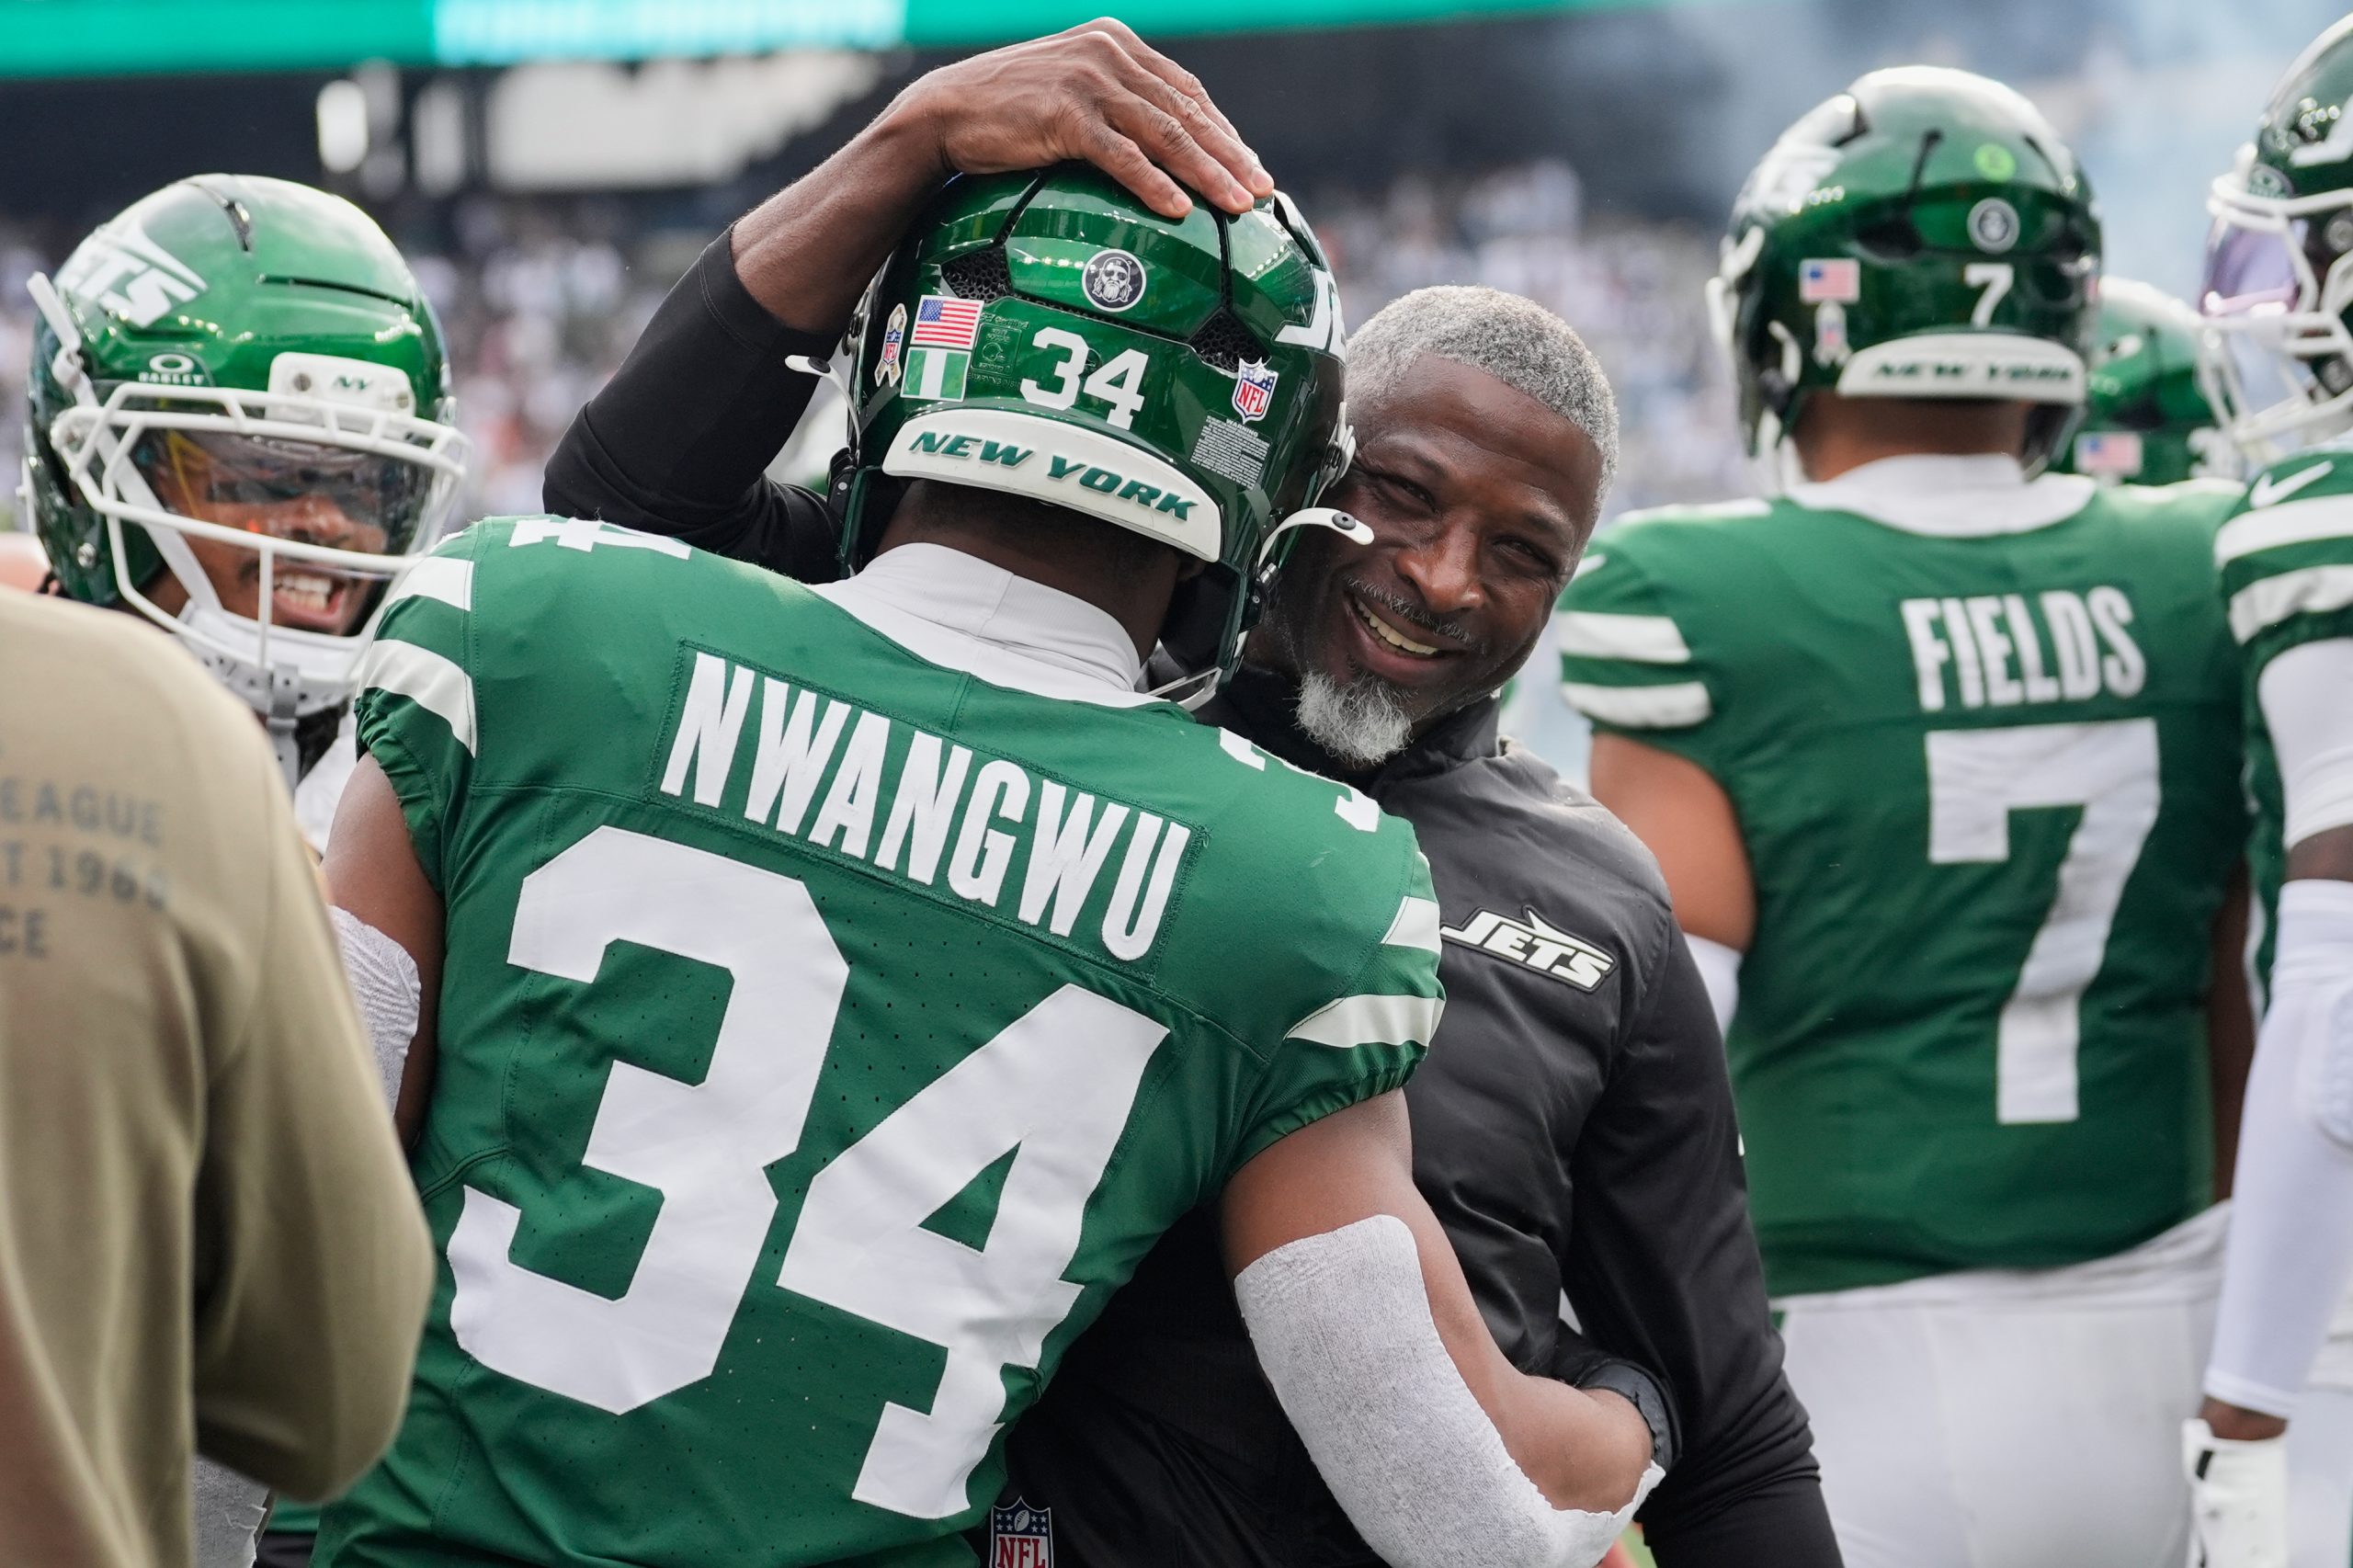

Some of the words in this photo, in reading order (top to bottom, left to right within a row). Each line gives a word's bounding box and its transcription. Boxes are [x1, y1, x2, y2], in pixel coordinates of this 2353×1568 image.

[1965, 264, 2013, 327] 7
[1019, 326, 1150, 431] 34
[1237, 382, 1265, 413] NFL
[1226, 418, 1258, 437] WARNING
[908, 431, 1035, 469] NEW
[1047, 455, 1199, 523] YORK
[1900, 585, 2147, 711] FIELDS
[659, 651, 1192, 961] NWANGWU
[1440, 906, 1615, 991] JETS
[1926, 717, 2162, 1125] 7
[447, 825, 1171, 1520] 34
[996, 1536, 1046, 1568] NFL
